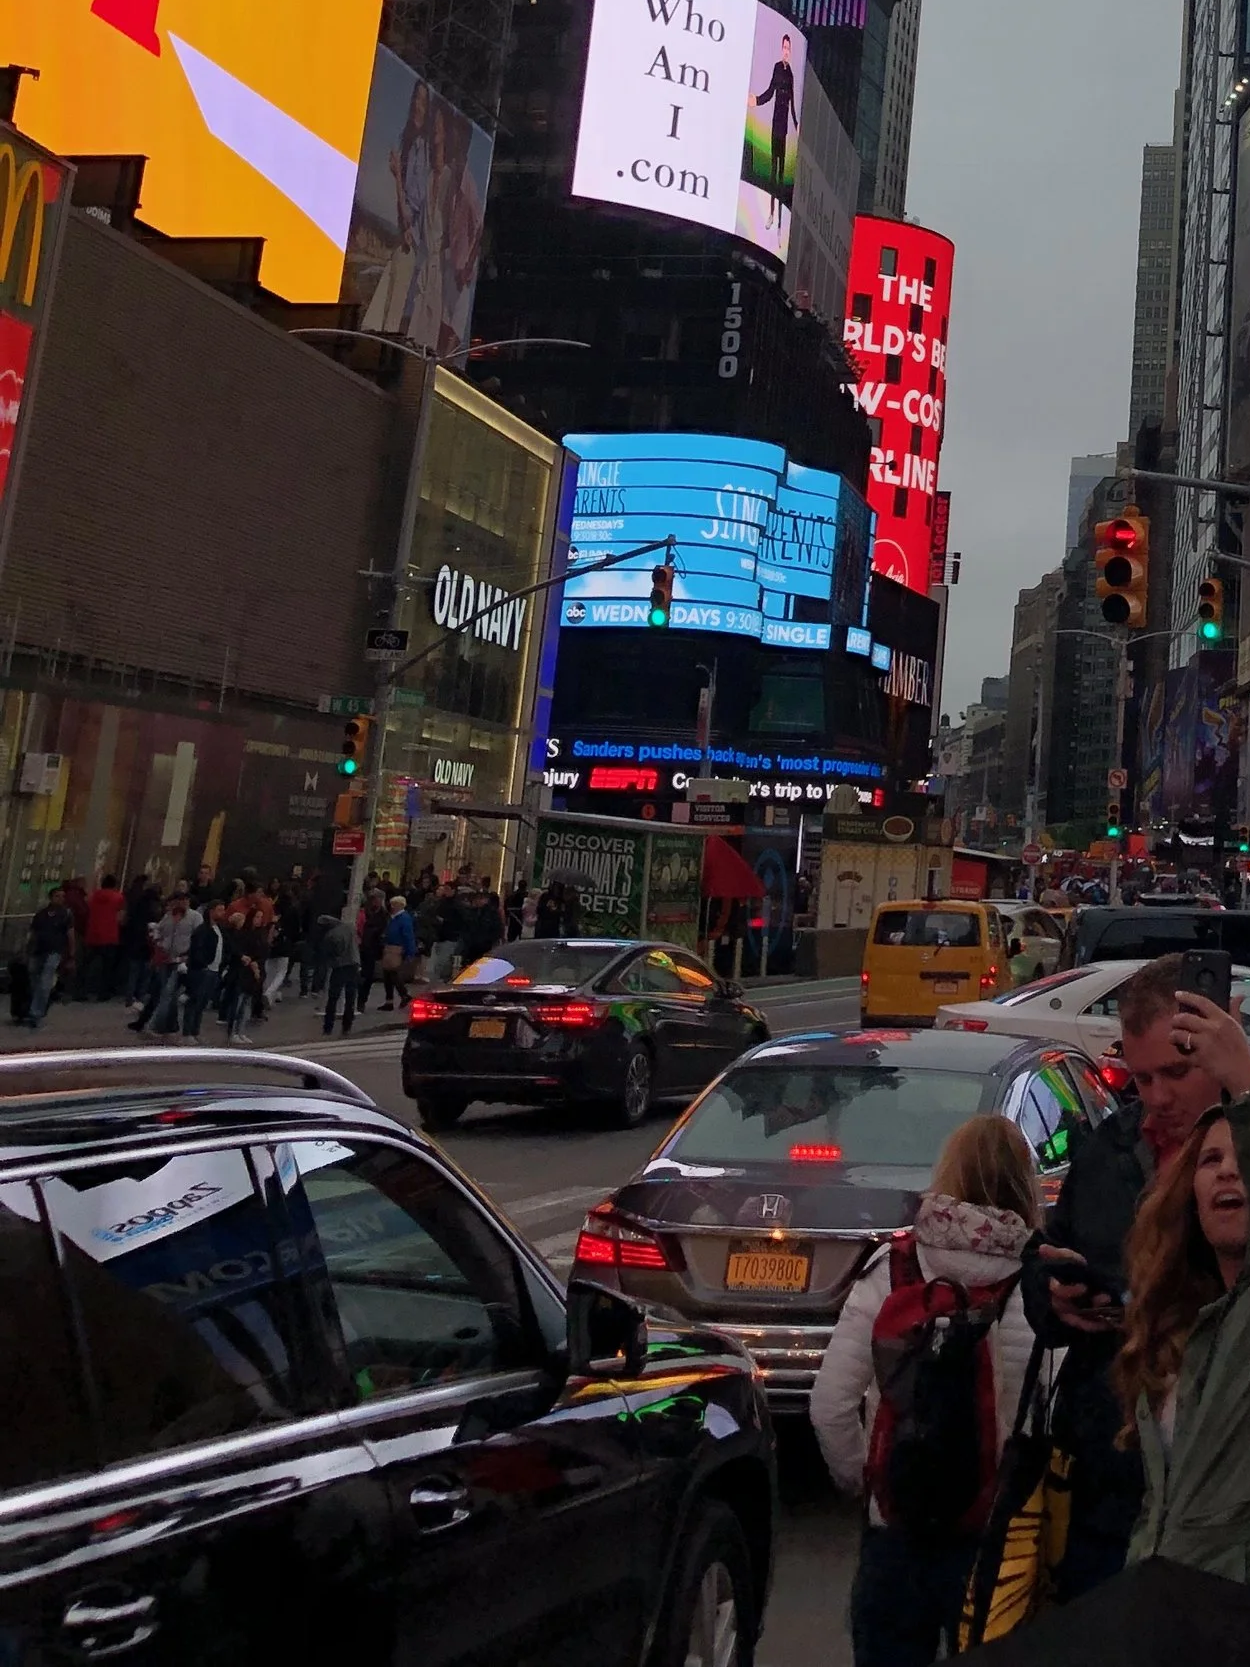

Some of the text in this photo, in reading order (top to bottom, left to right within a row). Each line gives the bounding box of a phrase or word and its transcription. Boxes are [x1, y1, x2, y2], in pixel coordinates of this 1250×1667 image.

[644, 45, 711, 94] Am
[665, 103, 684, 140] I
[616, 157, 710, 200] .com
[877, 273, 934, 313] THE
[843, 318, 926, 363] RLD'S
[869, 446, 936, 495] RLINE
[434, 564, 527, 651] OLD NAVY
[591, 604, 721, 627] WEDNDAYS
[766, 624, 828, 651] SINGLE
[573, 740, 634, 758] Sanders
[638, 743, 702, 762] pushes
[434, 757, 475, 787] OLD NAVY
[589, 767, 658, 790] ESPN
[774, 781, 802, 802] trip
[806, 784, 823, 799] to
[545, 832, 636, 855] DISCOVER
[579, 893, 629, 914] RETS
